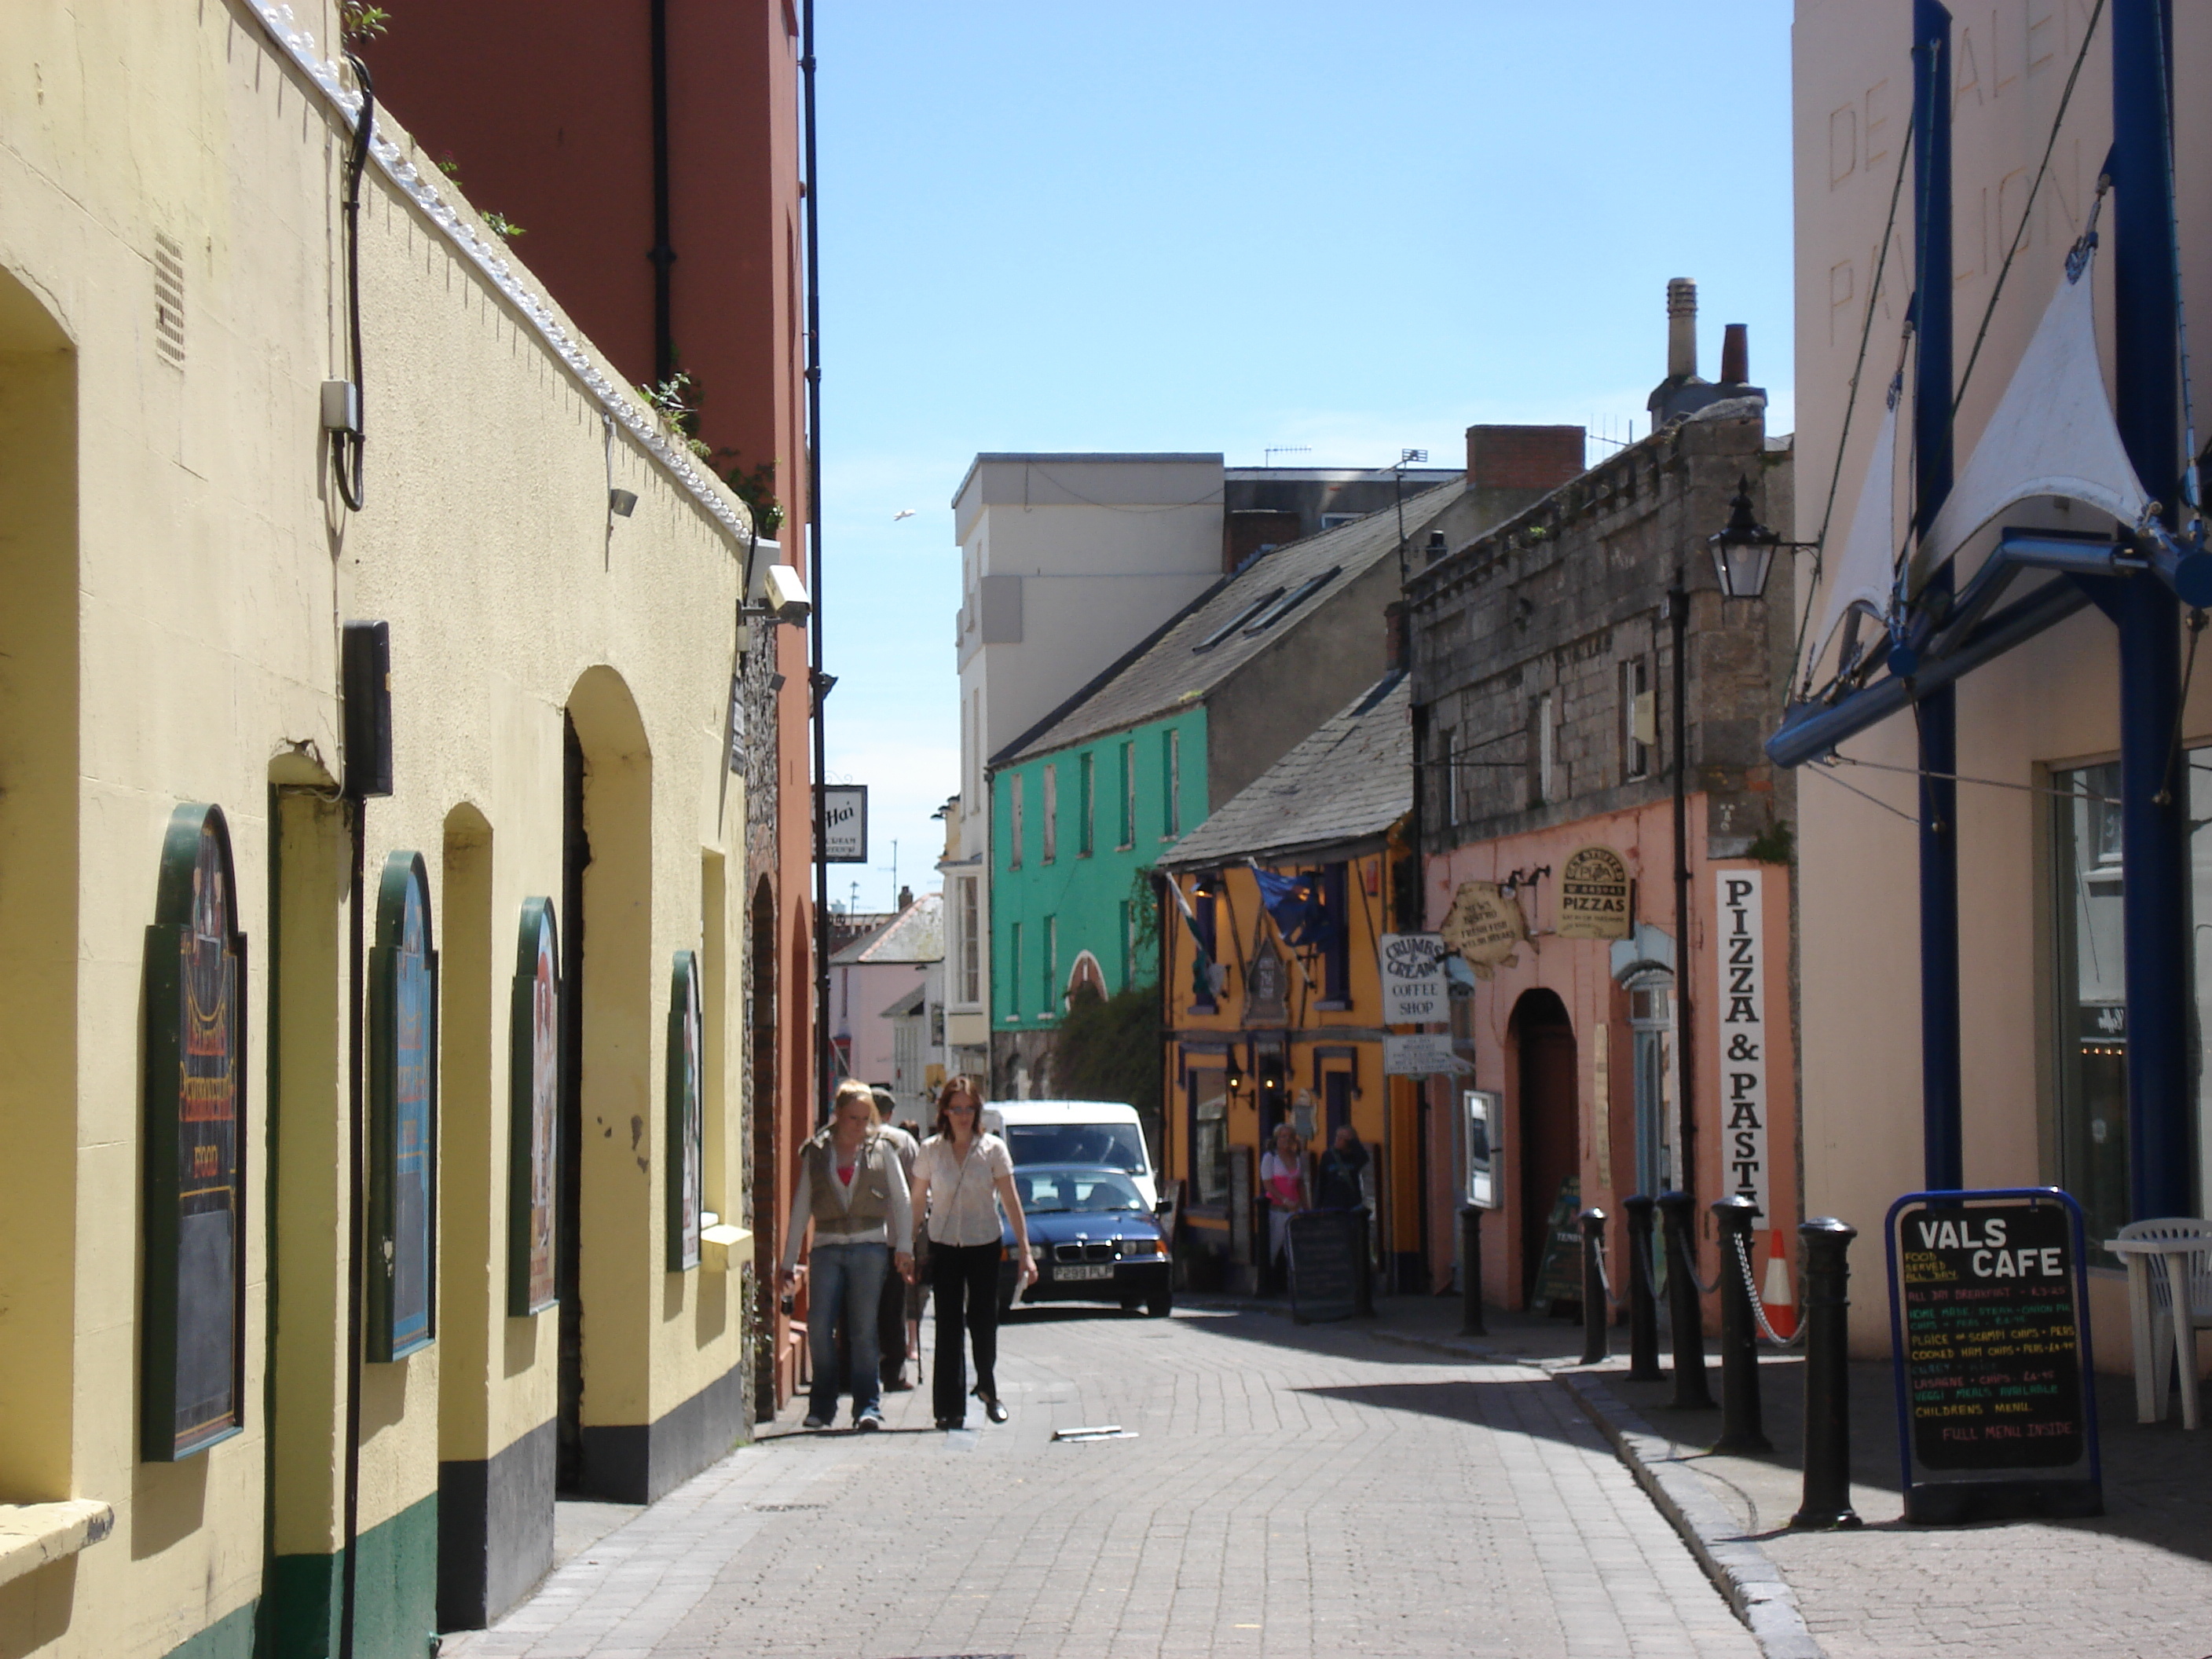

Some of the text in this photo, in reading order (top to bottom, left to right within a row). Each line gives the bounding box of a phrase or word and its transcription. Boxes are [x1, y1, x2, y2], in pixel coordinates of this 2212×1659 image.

[1563, 897, 1625, 912] PIZZAS
[1489, 921, 1507, 932] FISH
[1385, 938, 1443, 961] CRUMBS
[1725, 879, 1760, 1023] PIZZA
[1387, 960, 1438, 979] CREAM
[1393, 983, 1438, 997] COFFEE
[1400, 1002, 1434, 1016] SHOP
[1727, 1033, 1760, 1061] &
[1917, 1218, 2008, 1249] VALS
[1905, 1251, 1937, 1262] FOOD
[1972, 1247, 2064, 1279] CAFE
[1905, 1261, 1946, 1273] SERVED
[1908, 1291, 1927, 1302] ALL
[1954, 1286, 2012, 1300] BREAKFAST
[1909, 1307, 1936, 1320] HOME
[1910, 1320, 1937, 1331] CHIPS
[1911, 1333, 1950, 1346] PLAICE
[1968, 1328, 2005, 1343] SCAMPI
[2010, 1328, 2040, 1339] CHIPS
[2049, 1324, 2075, 1337] PEAS
[1912, 1348, 1955, 1361] COOKED
[1961, 1346, 1983, 1357] HAM
[1987, 1343, 2016, 1357] CHIPS
[1914, 1375, 1964, 1390] LASAGNE
[1978, 1372, 2012, 1385] CHIPS
[1955, 1386, 1994, 1399] MEALS
[1998, 1383, 2059, 1397] AVAILABLE
[1914, 1402, 1985, 1419] CHILDRENS
[1942, 1426, 1979, 1442] FULL
[1984, 1424, 2023, 1439] MENU
